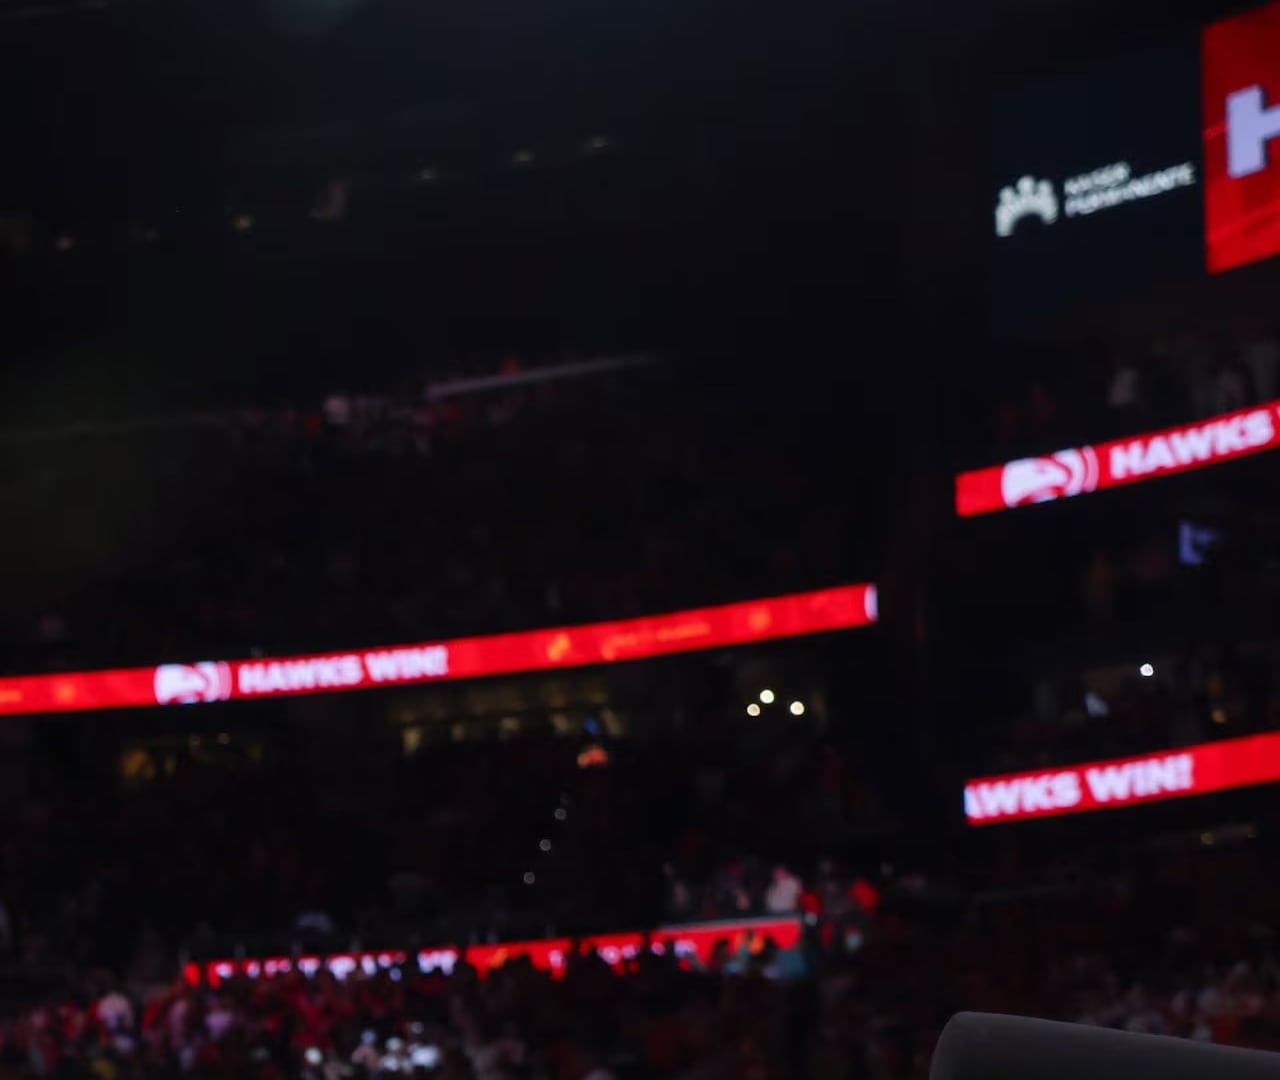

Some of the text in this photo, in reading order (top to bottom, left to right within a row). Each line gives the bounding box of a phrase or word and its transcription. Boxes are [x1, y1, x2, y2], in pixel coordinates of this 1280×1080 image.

[1110, 409, 1275, 480] HAWKS
[239, 644, 448, 695] HAWKS WIN!
[1084, 752, 1194, 803] WIN!
